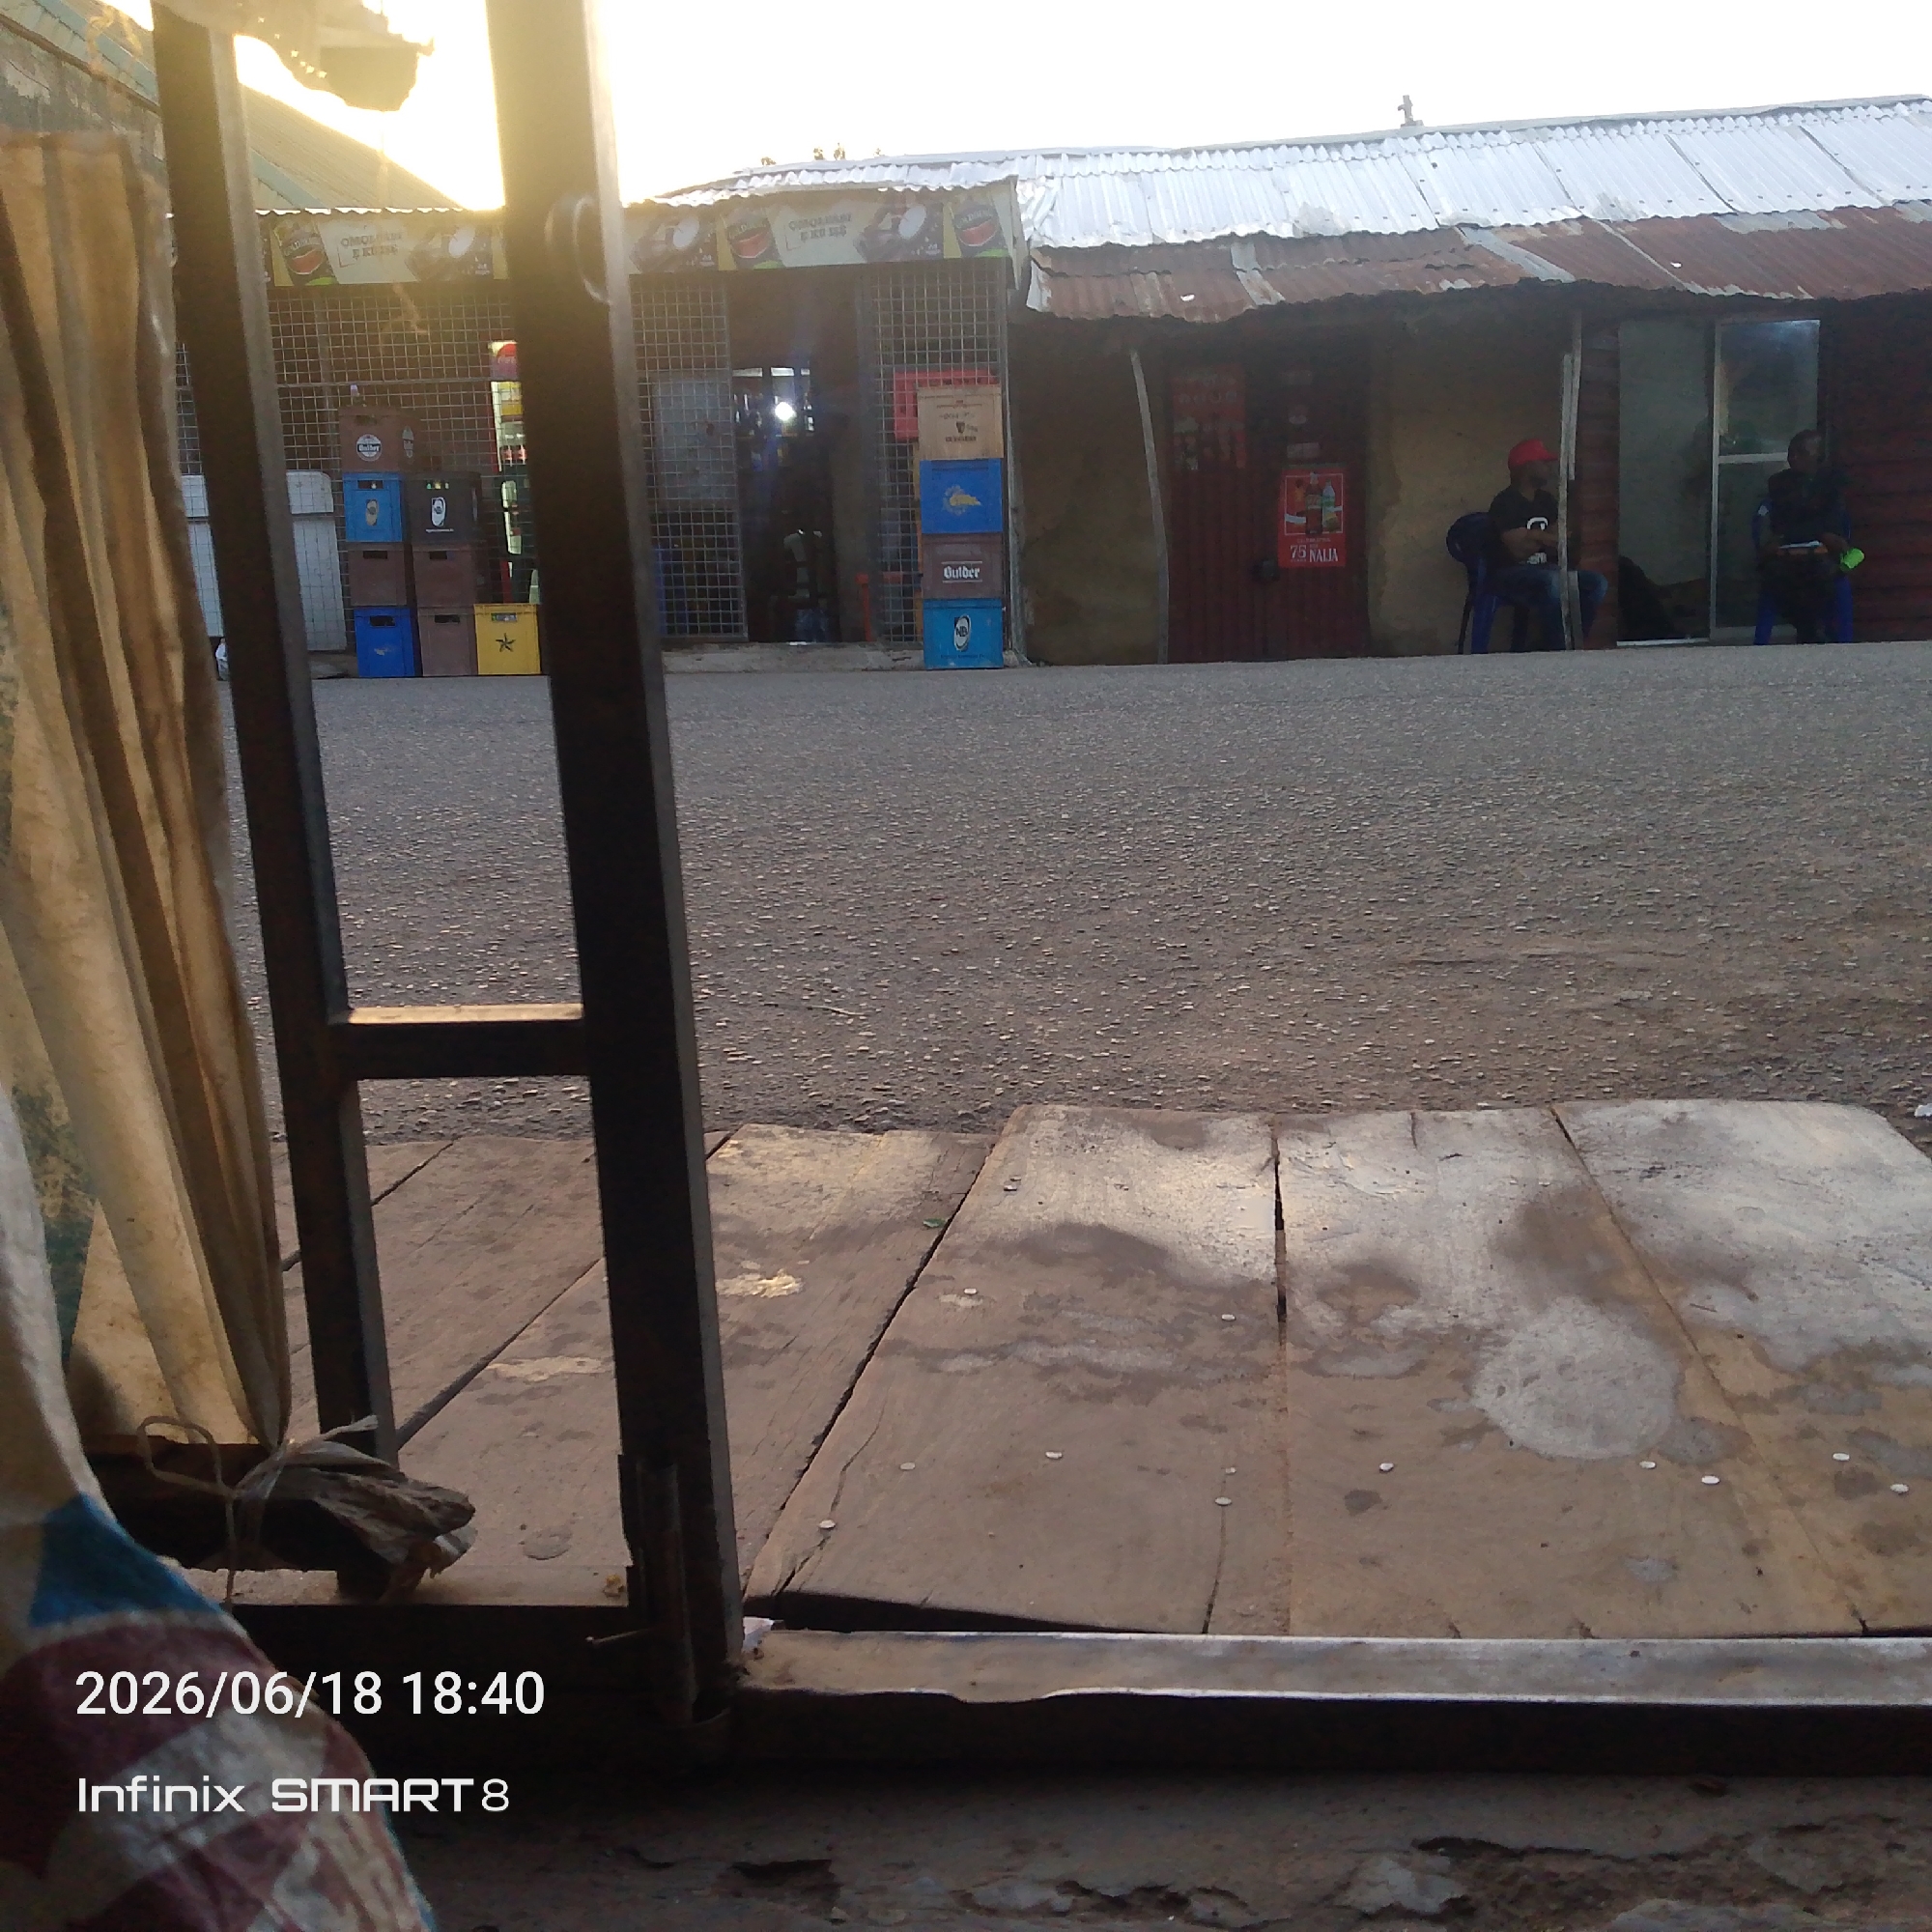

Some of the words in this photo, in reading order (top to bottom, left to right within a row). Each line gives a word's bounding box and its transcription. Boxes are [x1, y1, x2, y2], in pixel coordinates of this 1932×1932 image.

[1290, 545, 1307, 558] 75
[1309, 548, 1339, 563] NAIJA
[943, 565, 980, 580] Gulder
